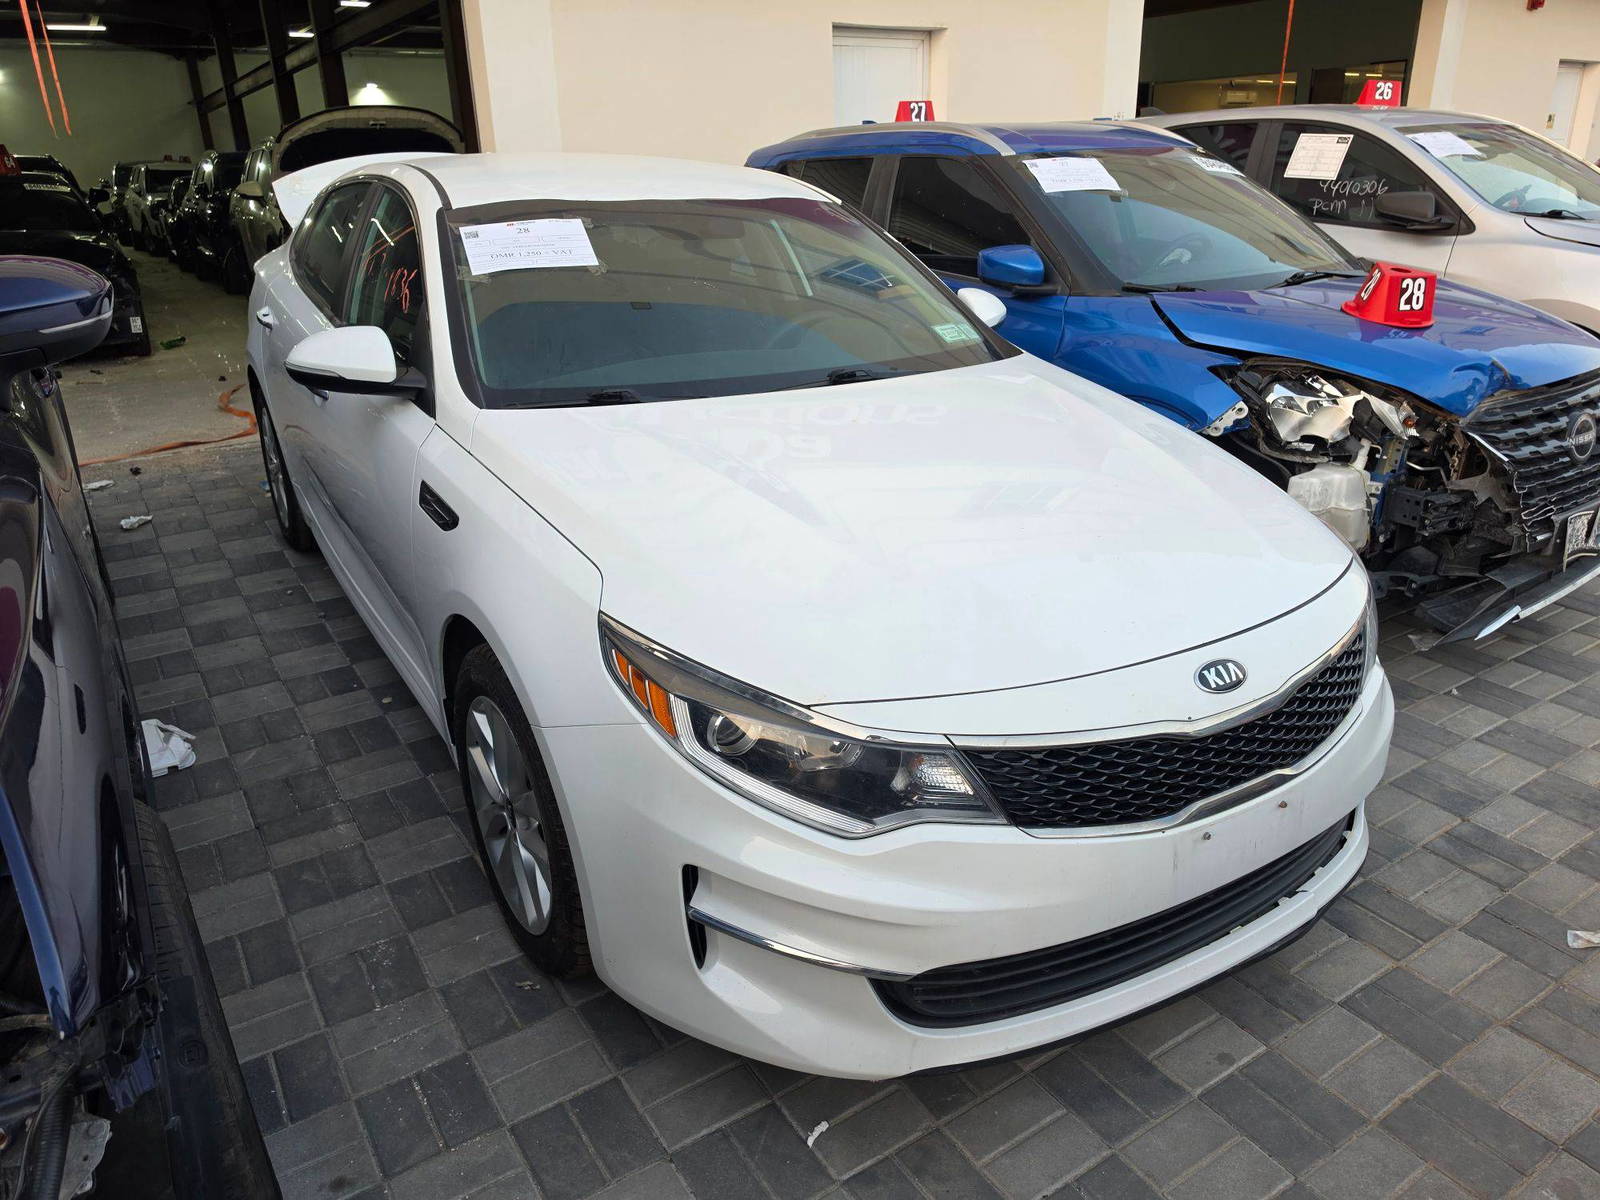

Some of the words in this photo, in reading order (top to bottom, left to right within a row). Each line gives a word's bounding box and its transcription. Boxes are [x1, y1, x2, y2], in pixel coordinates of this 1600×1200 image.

[1375, 81, 1393, 100] 26
[910, 102, 926, 122] 27
[516, 227, 531, 235] 28
[1399, 277, 1426, 311] 28
[1201, 662, 1244, 689] KIA
